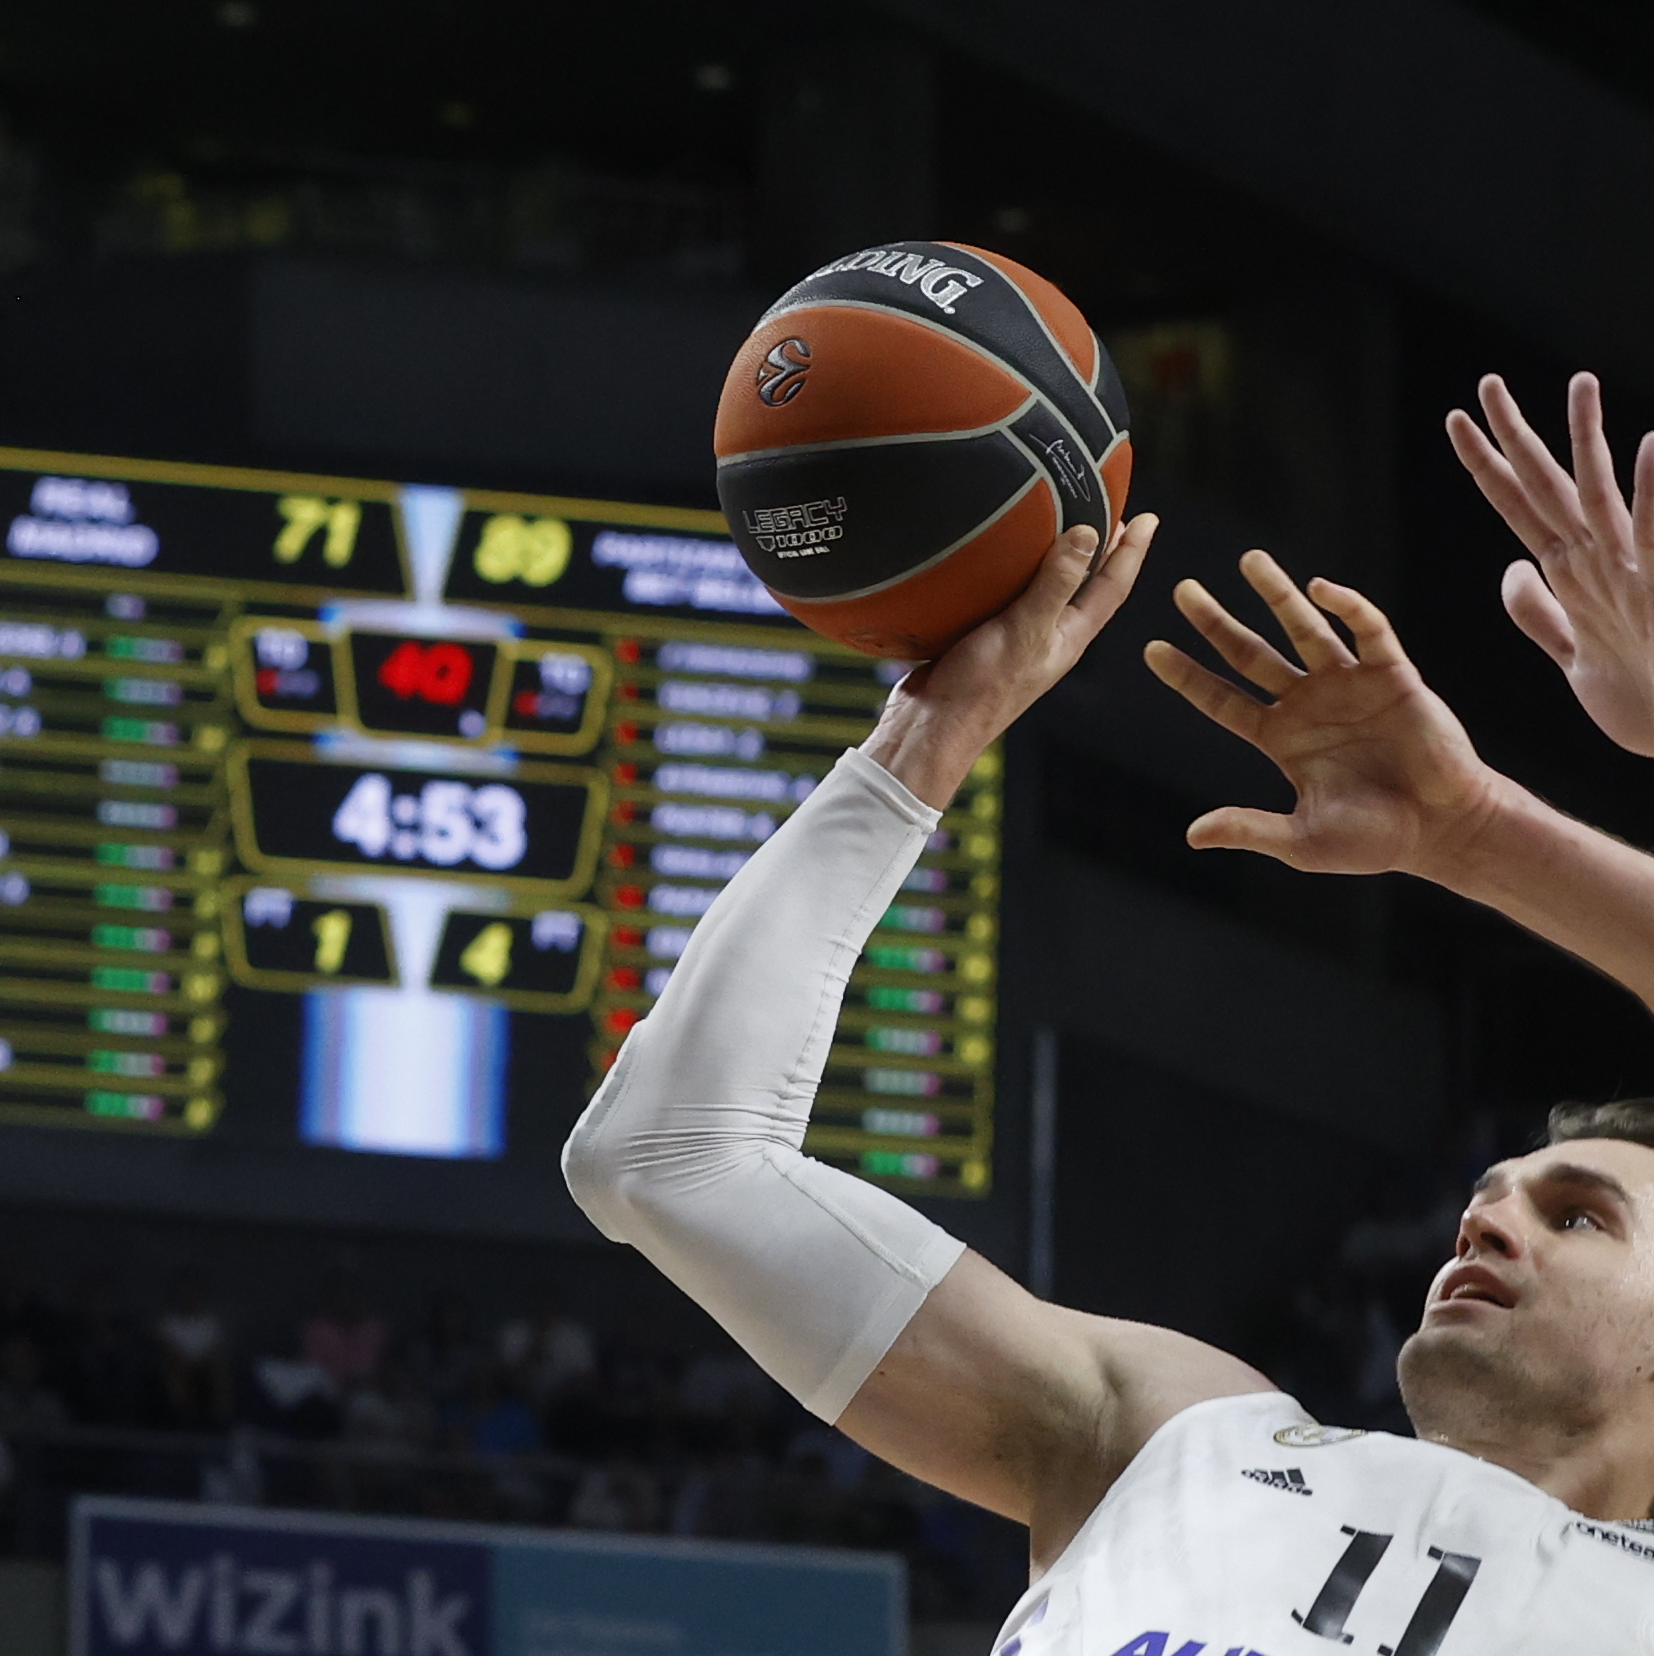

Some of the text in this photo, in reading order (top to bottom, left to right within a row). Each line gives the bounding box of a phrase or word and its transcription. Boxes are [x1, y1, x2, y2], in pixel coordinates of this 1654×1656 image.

[274, 495, 362, 569] 71
[742, 496, 848, 534] LEGACY
[775, 525, 844, 549] 1000
[332, 772, 529, 870] 4:53
